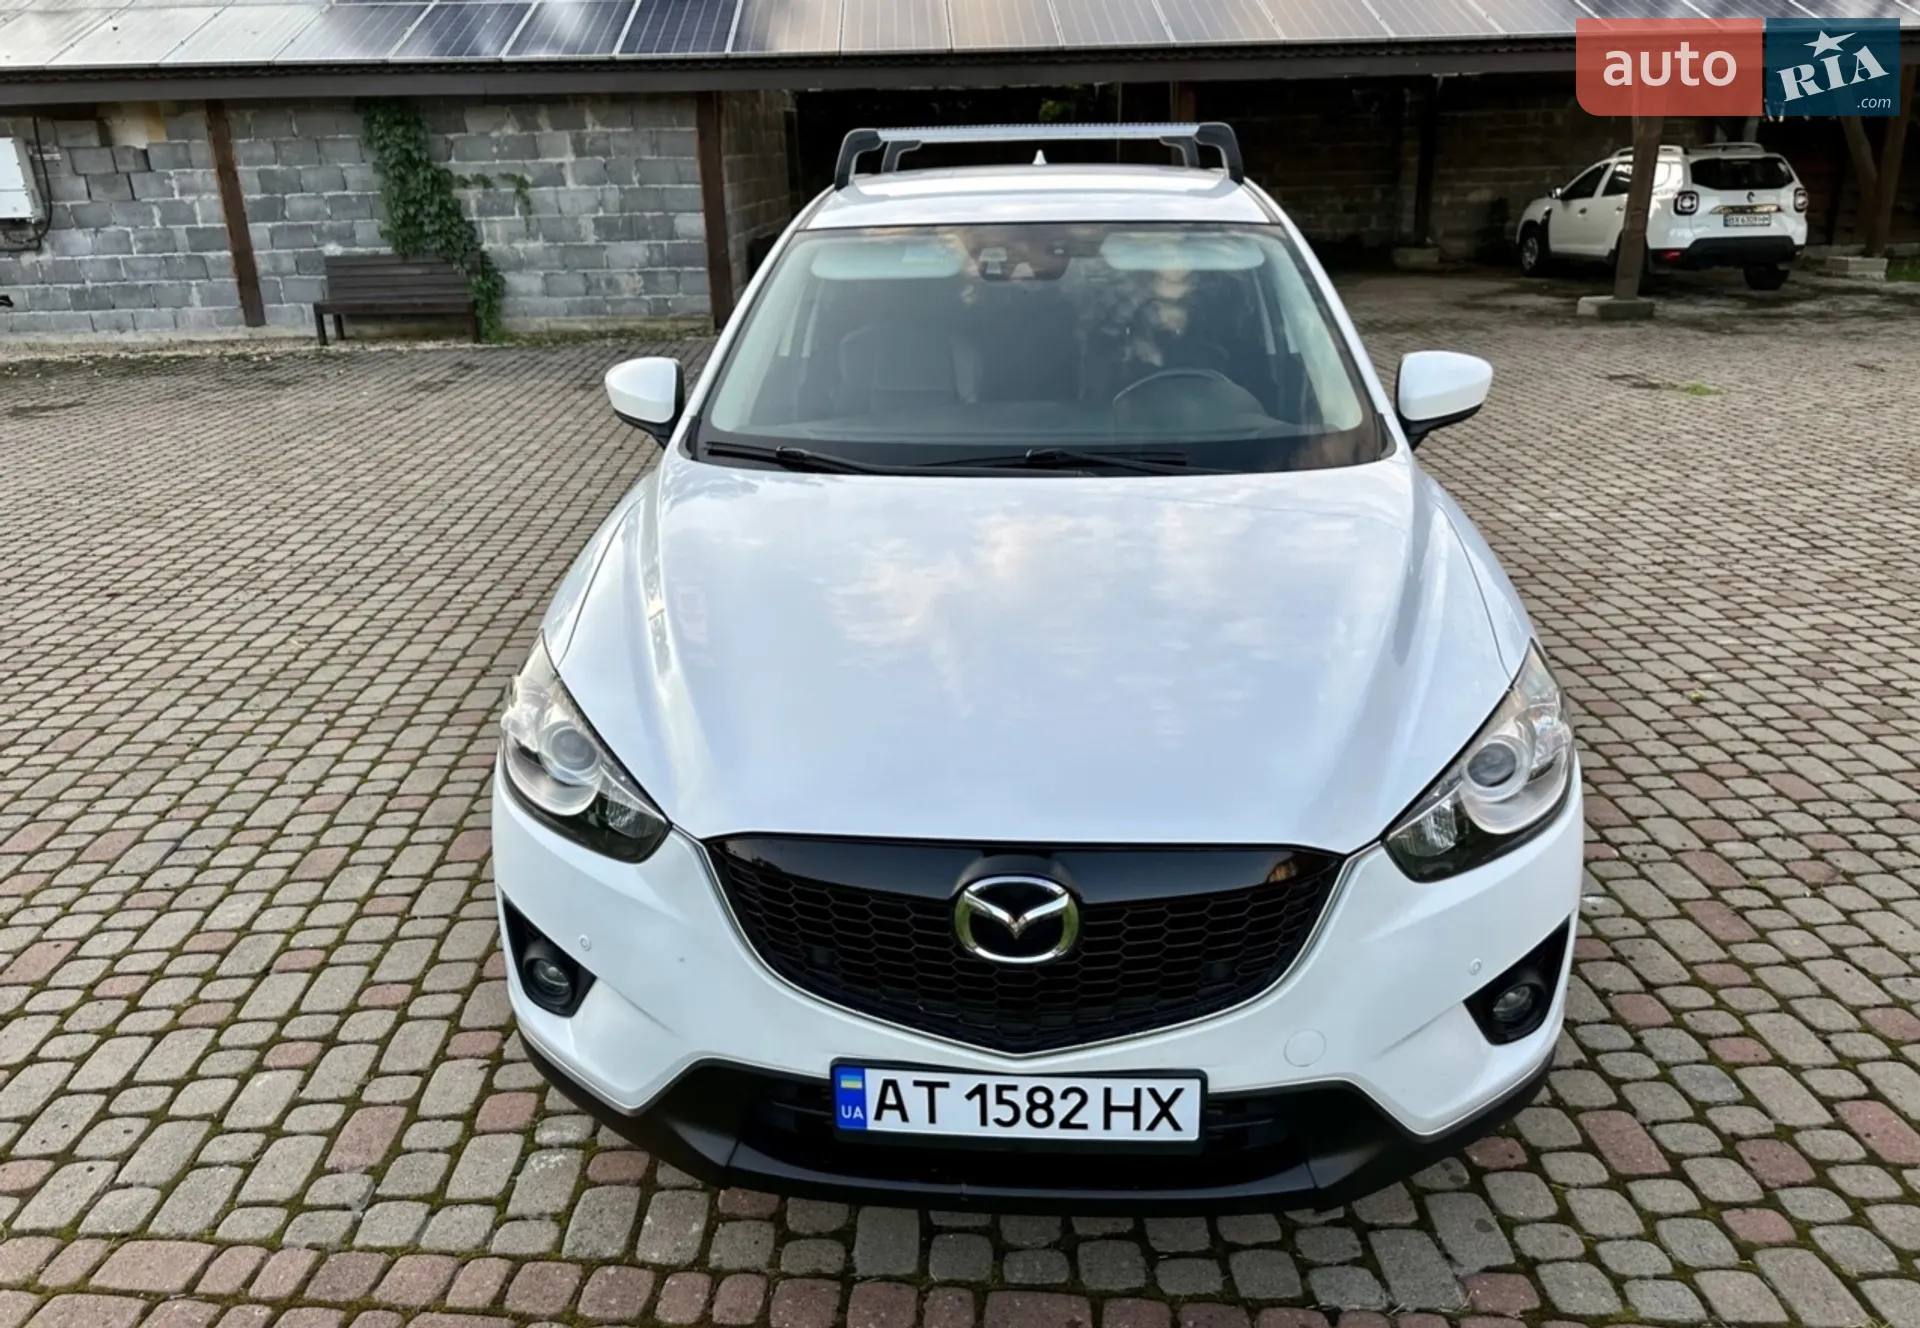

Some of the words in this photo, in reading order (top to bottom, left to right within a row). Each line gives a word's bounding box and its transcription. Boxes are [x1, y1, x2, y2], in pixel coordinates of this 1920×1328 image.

[841, 1106, 864, 1120] UA
[873, 1079, 950, 1124] AT
[964, 1083, 1088, 1131] 1582
[1103, 1087, 1185, 1132] HX
